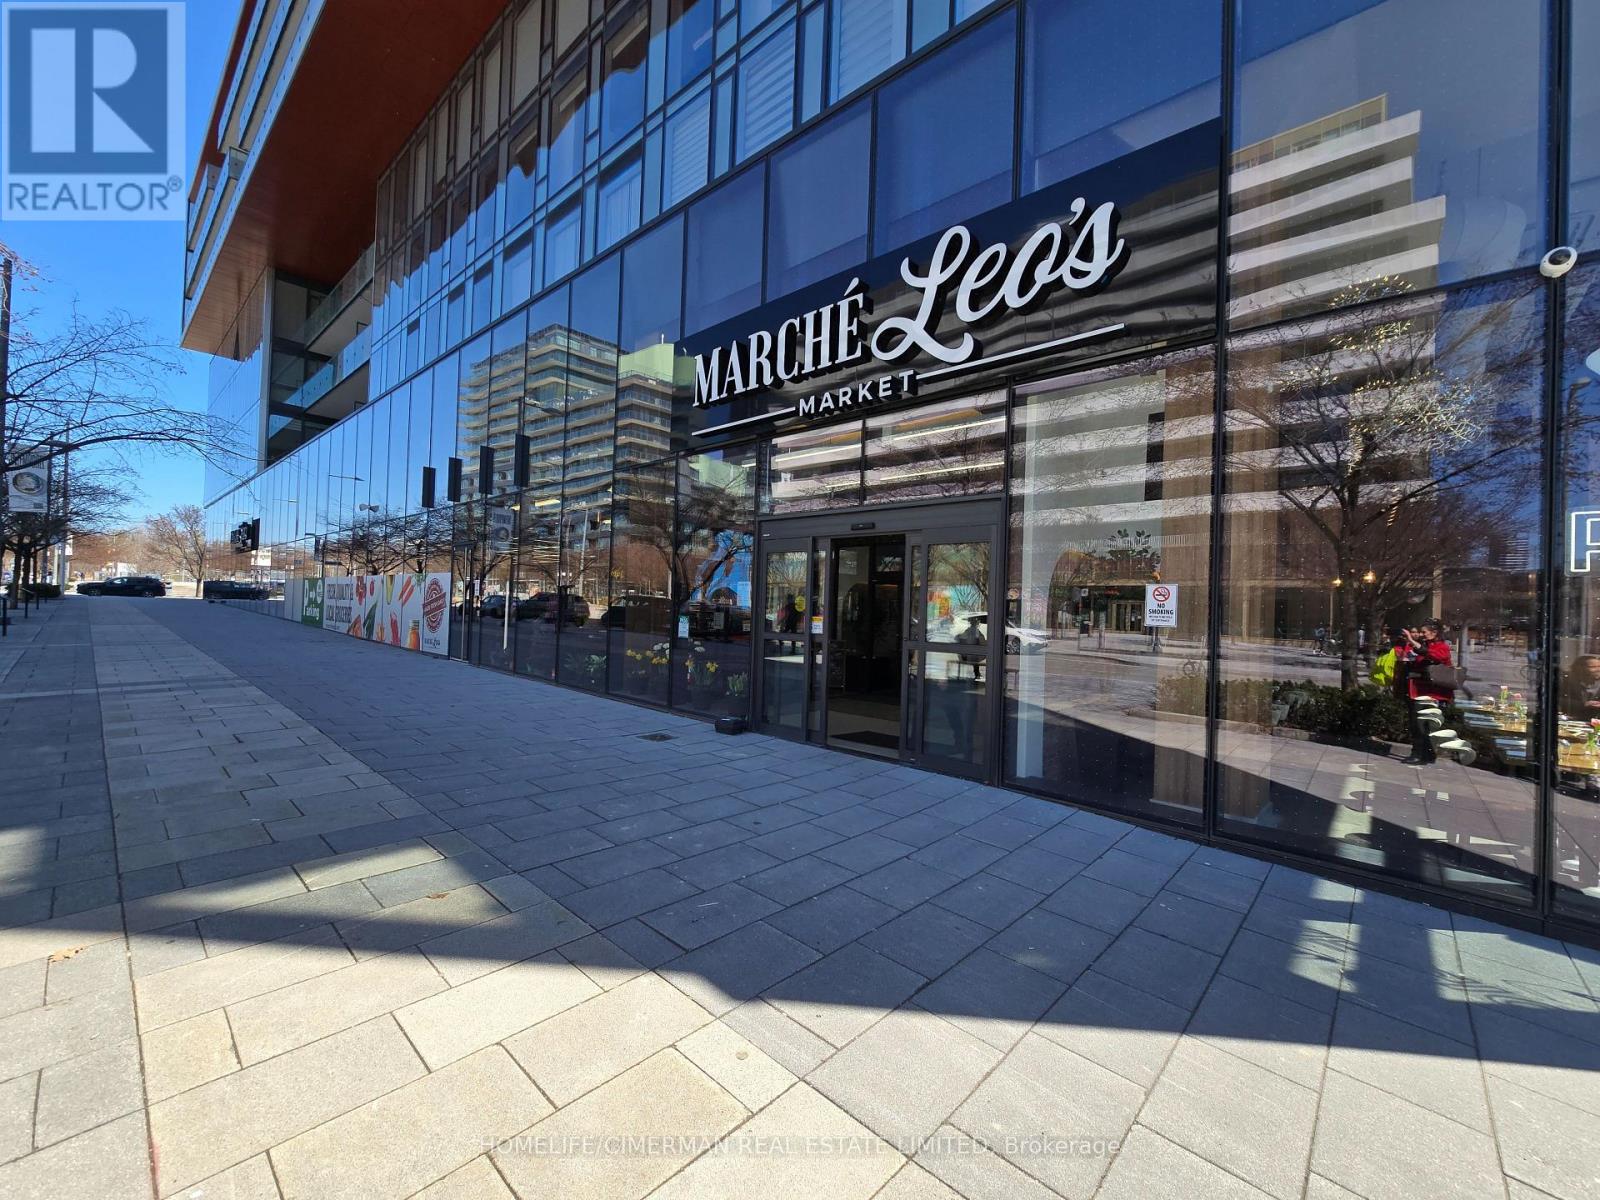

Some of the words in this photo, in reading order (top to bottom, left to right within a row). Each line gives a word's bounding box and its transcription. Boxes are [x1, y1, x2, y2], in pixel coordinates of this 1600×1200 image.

[692, 277, 865, 409] MARCHÉ
[870, 196, 1126, 364] Leo's
[798, 369, 917, 417] MARKET
